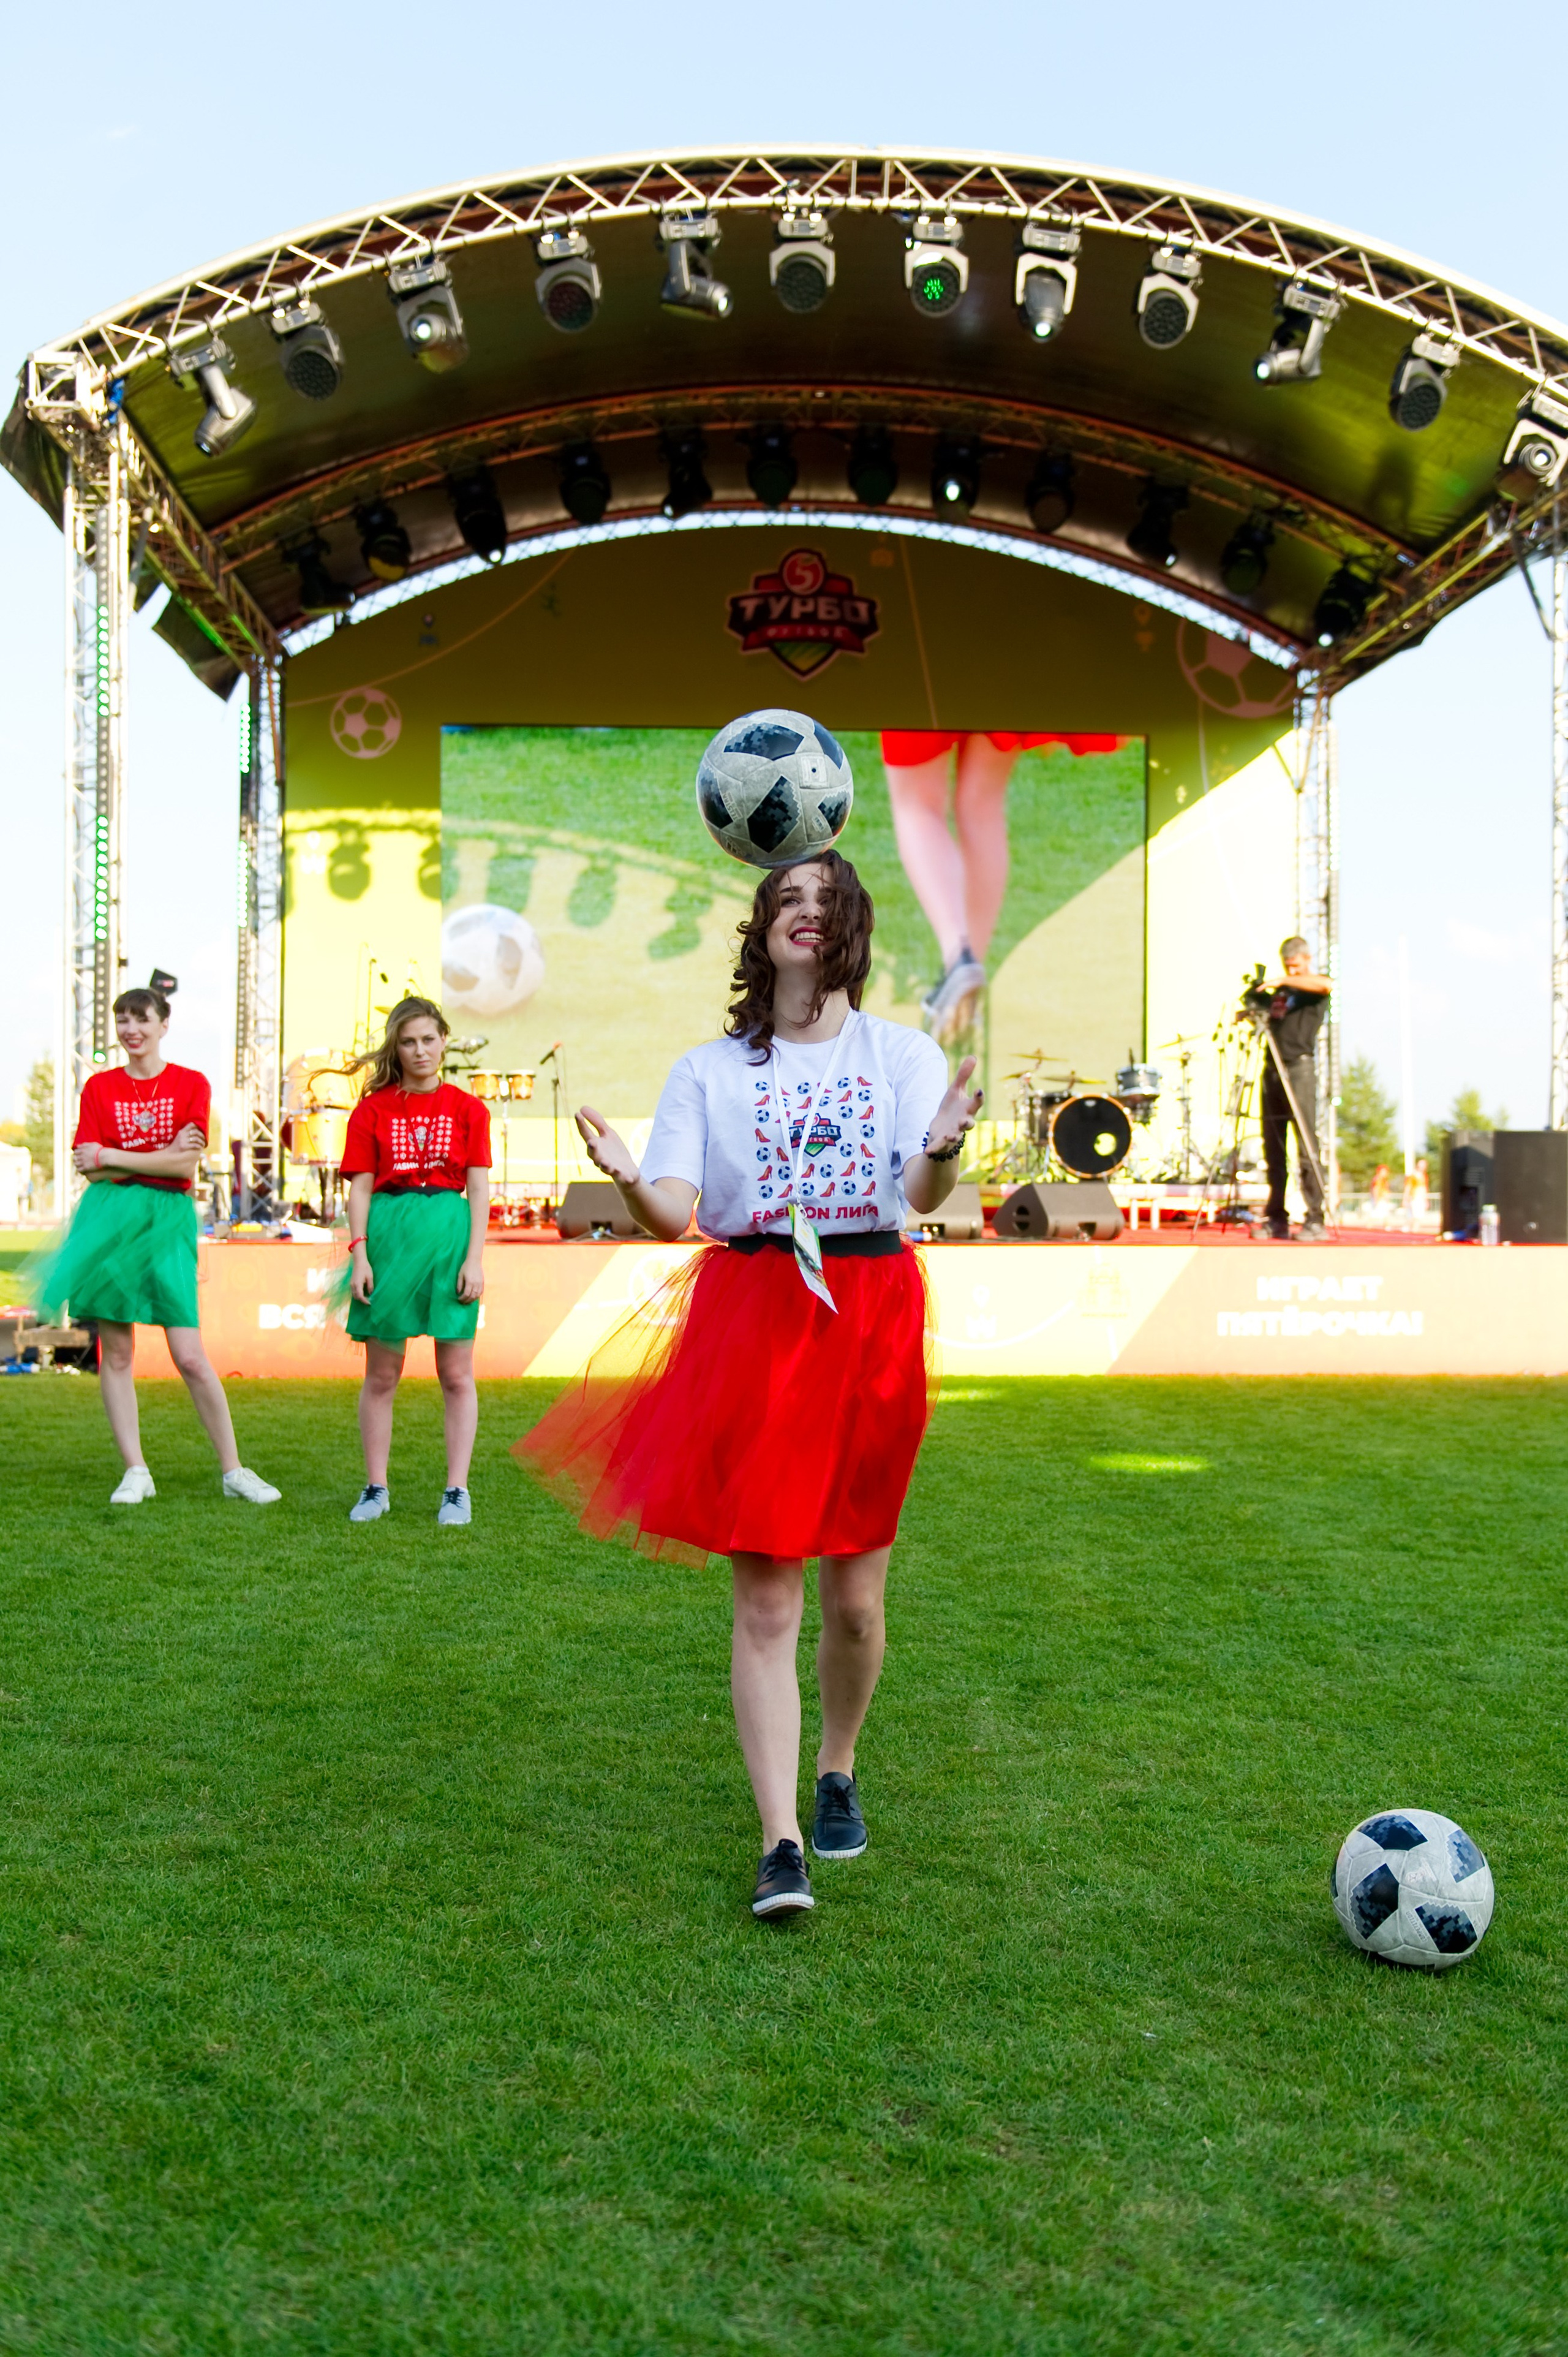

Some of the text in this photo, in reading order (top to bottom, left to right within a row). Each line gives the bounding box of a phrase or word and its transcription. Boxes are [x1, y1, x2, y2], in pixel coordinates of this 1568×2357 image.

[738, 596, 870, 624] ТУРБО
[752, 1203, 878, 1222] FASON ЛИГА
[1256, 1276, 1383, 1301] ИГРАЕТ
[1217, 1305, 1423, 1336] ПЯТЁРОЧКА!
